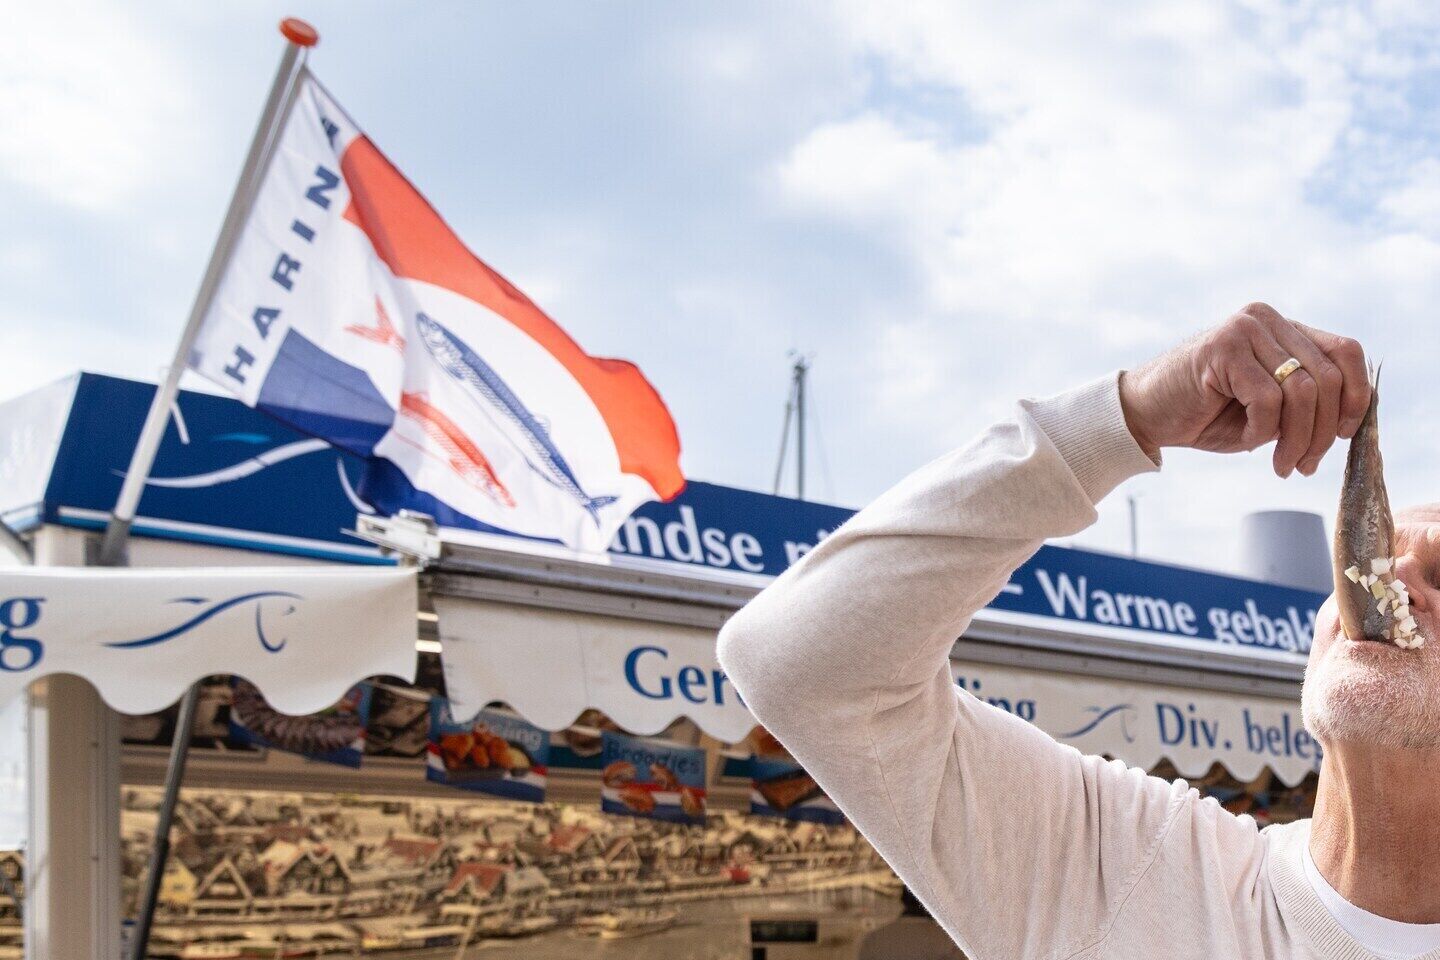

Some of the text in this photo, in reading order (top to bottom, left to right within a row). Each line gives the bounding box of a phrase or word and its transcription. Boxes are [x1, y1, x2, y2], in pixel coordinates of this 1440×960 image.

[609, 504, 765, 573] ndse
[1035, 568, 1199, 636] Warme
[1208, 598, 1316, 652] gebak
[0, 596, 47, 672] g
[623, 645, 750, 710] Ger
[1156, 703, 1232, 750] Div.
